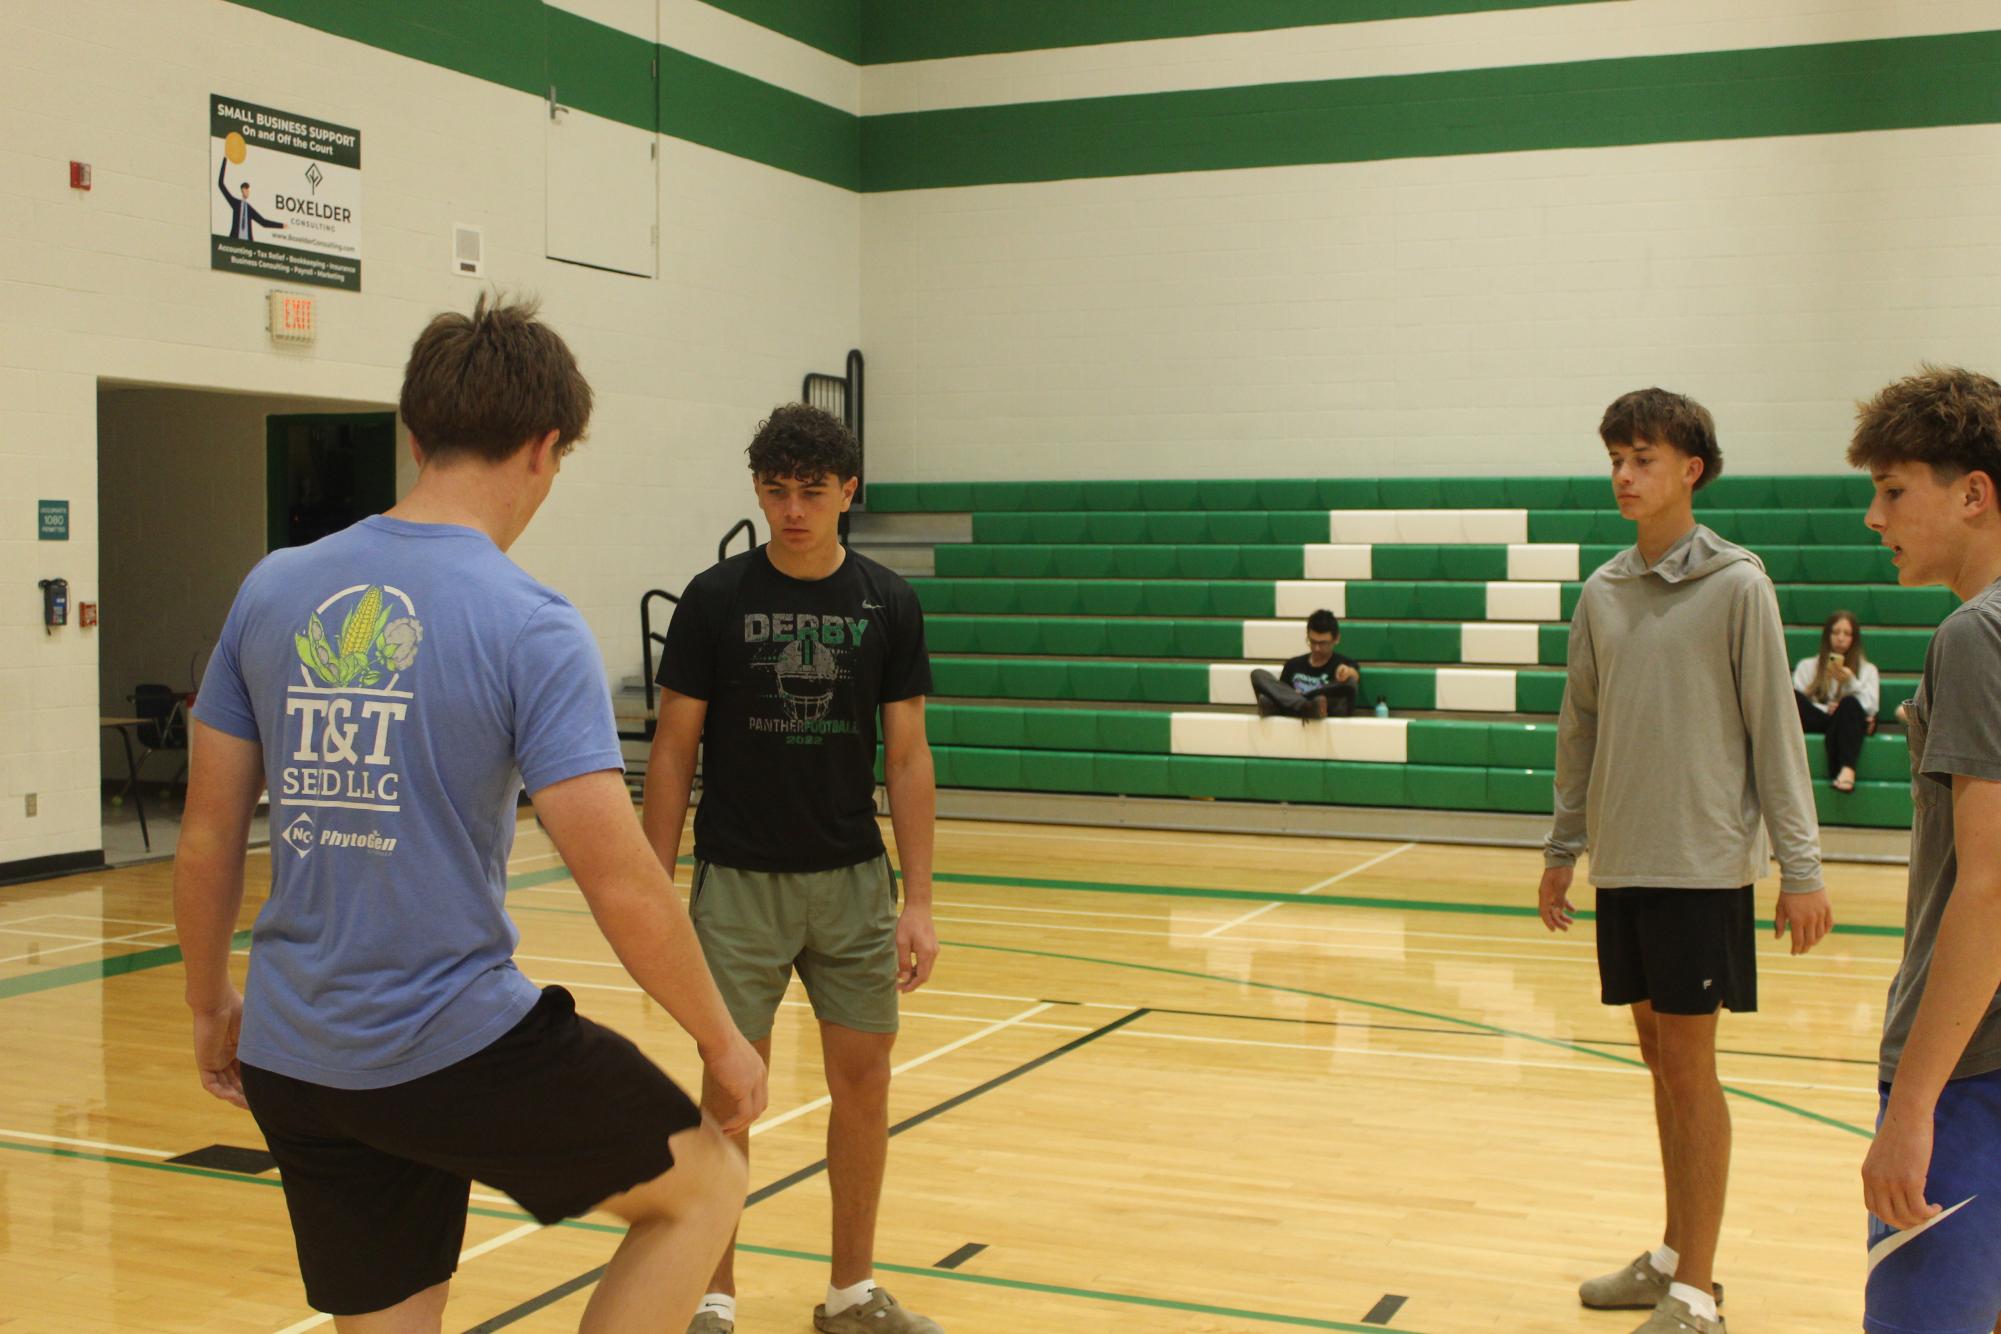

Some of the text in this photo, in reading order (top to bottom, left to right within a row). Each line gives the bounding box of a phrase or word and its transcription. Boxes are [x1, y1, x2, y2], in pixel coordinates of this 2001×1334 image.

[217, 104, 356, 147] SMALL BUSINESS SUPPORT
[242, 125, 333, 156] On and Off the Court
[275, 194, 352, 224] BOXELDER
[290, 218, 336, 232] CONSULTING
[744, 613, 869, 647] DERBY
[286, 697, 408, 766] T&T
[283, 767, 399, 801] SED LLC
[320, 830, 397, 852] PhytoGen
